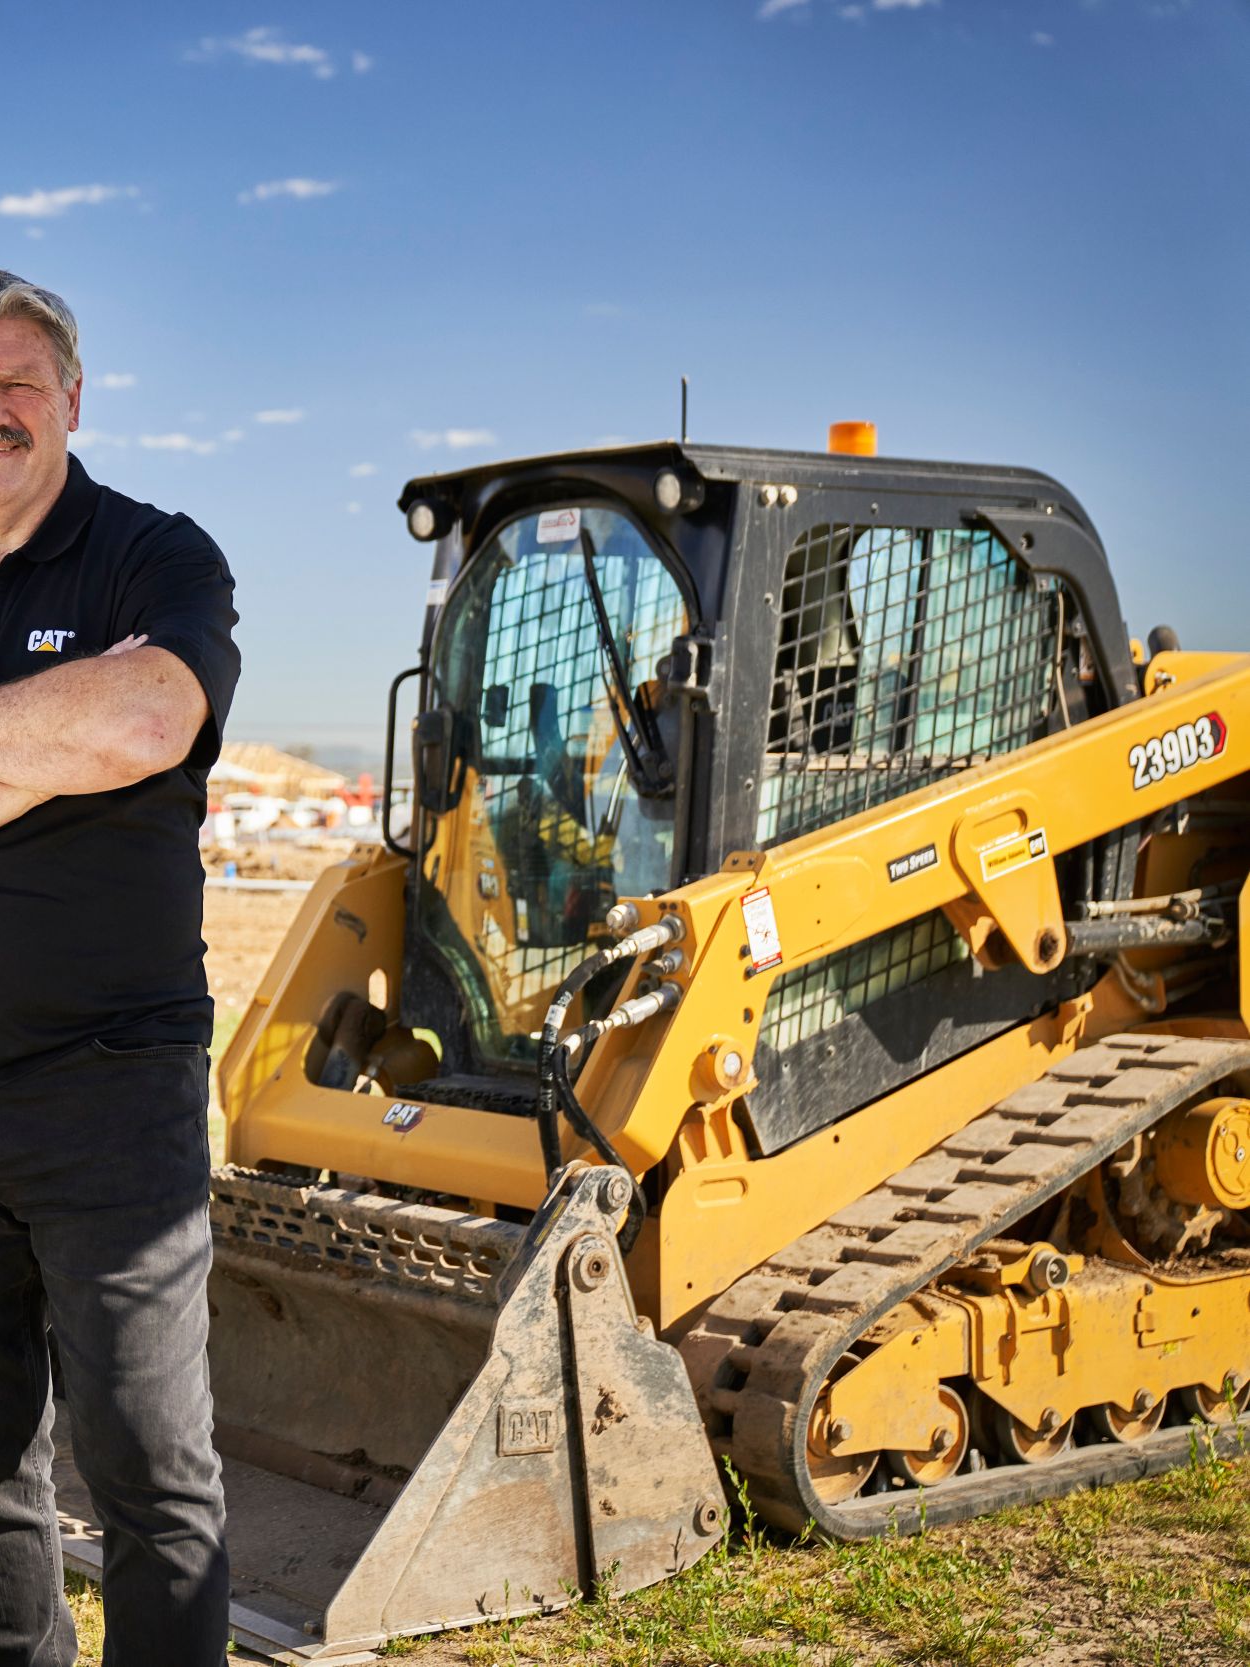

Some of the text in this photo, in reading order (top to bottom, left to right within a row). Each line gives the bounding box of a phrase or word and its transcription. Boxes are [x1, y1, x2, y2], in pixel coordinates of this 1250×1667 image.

[1129, 715, 1215, 790] 239D3
[382, 1102, 422, 1127] CAT
[539, 1087, 553, 1112] CAT
[508, 1409, 553, 1444] CAT
